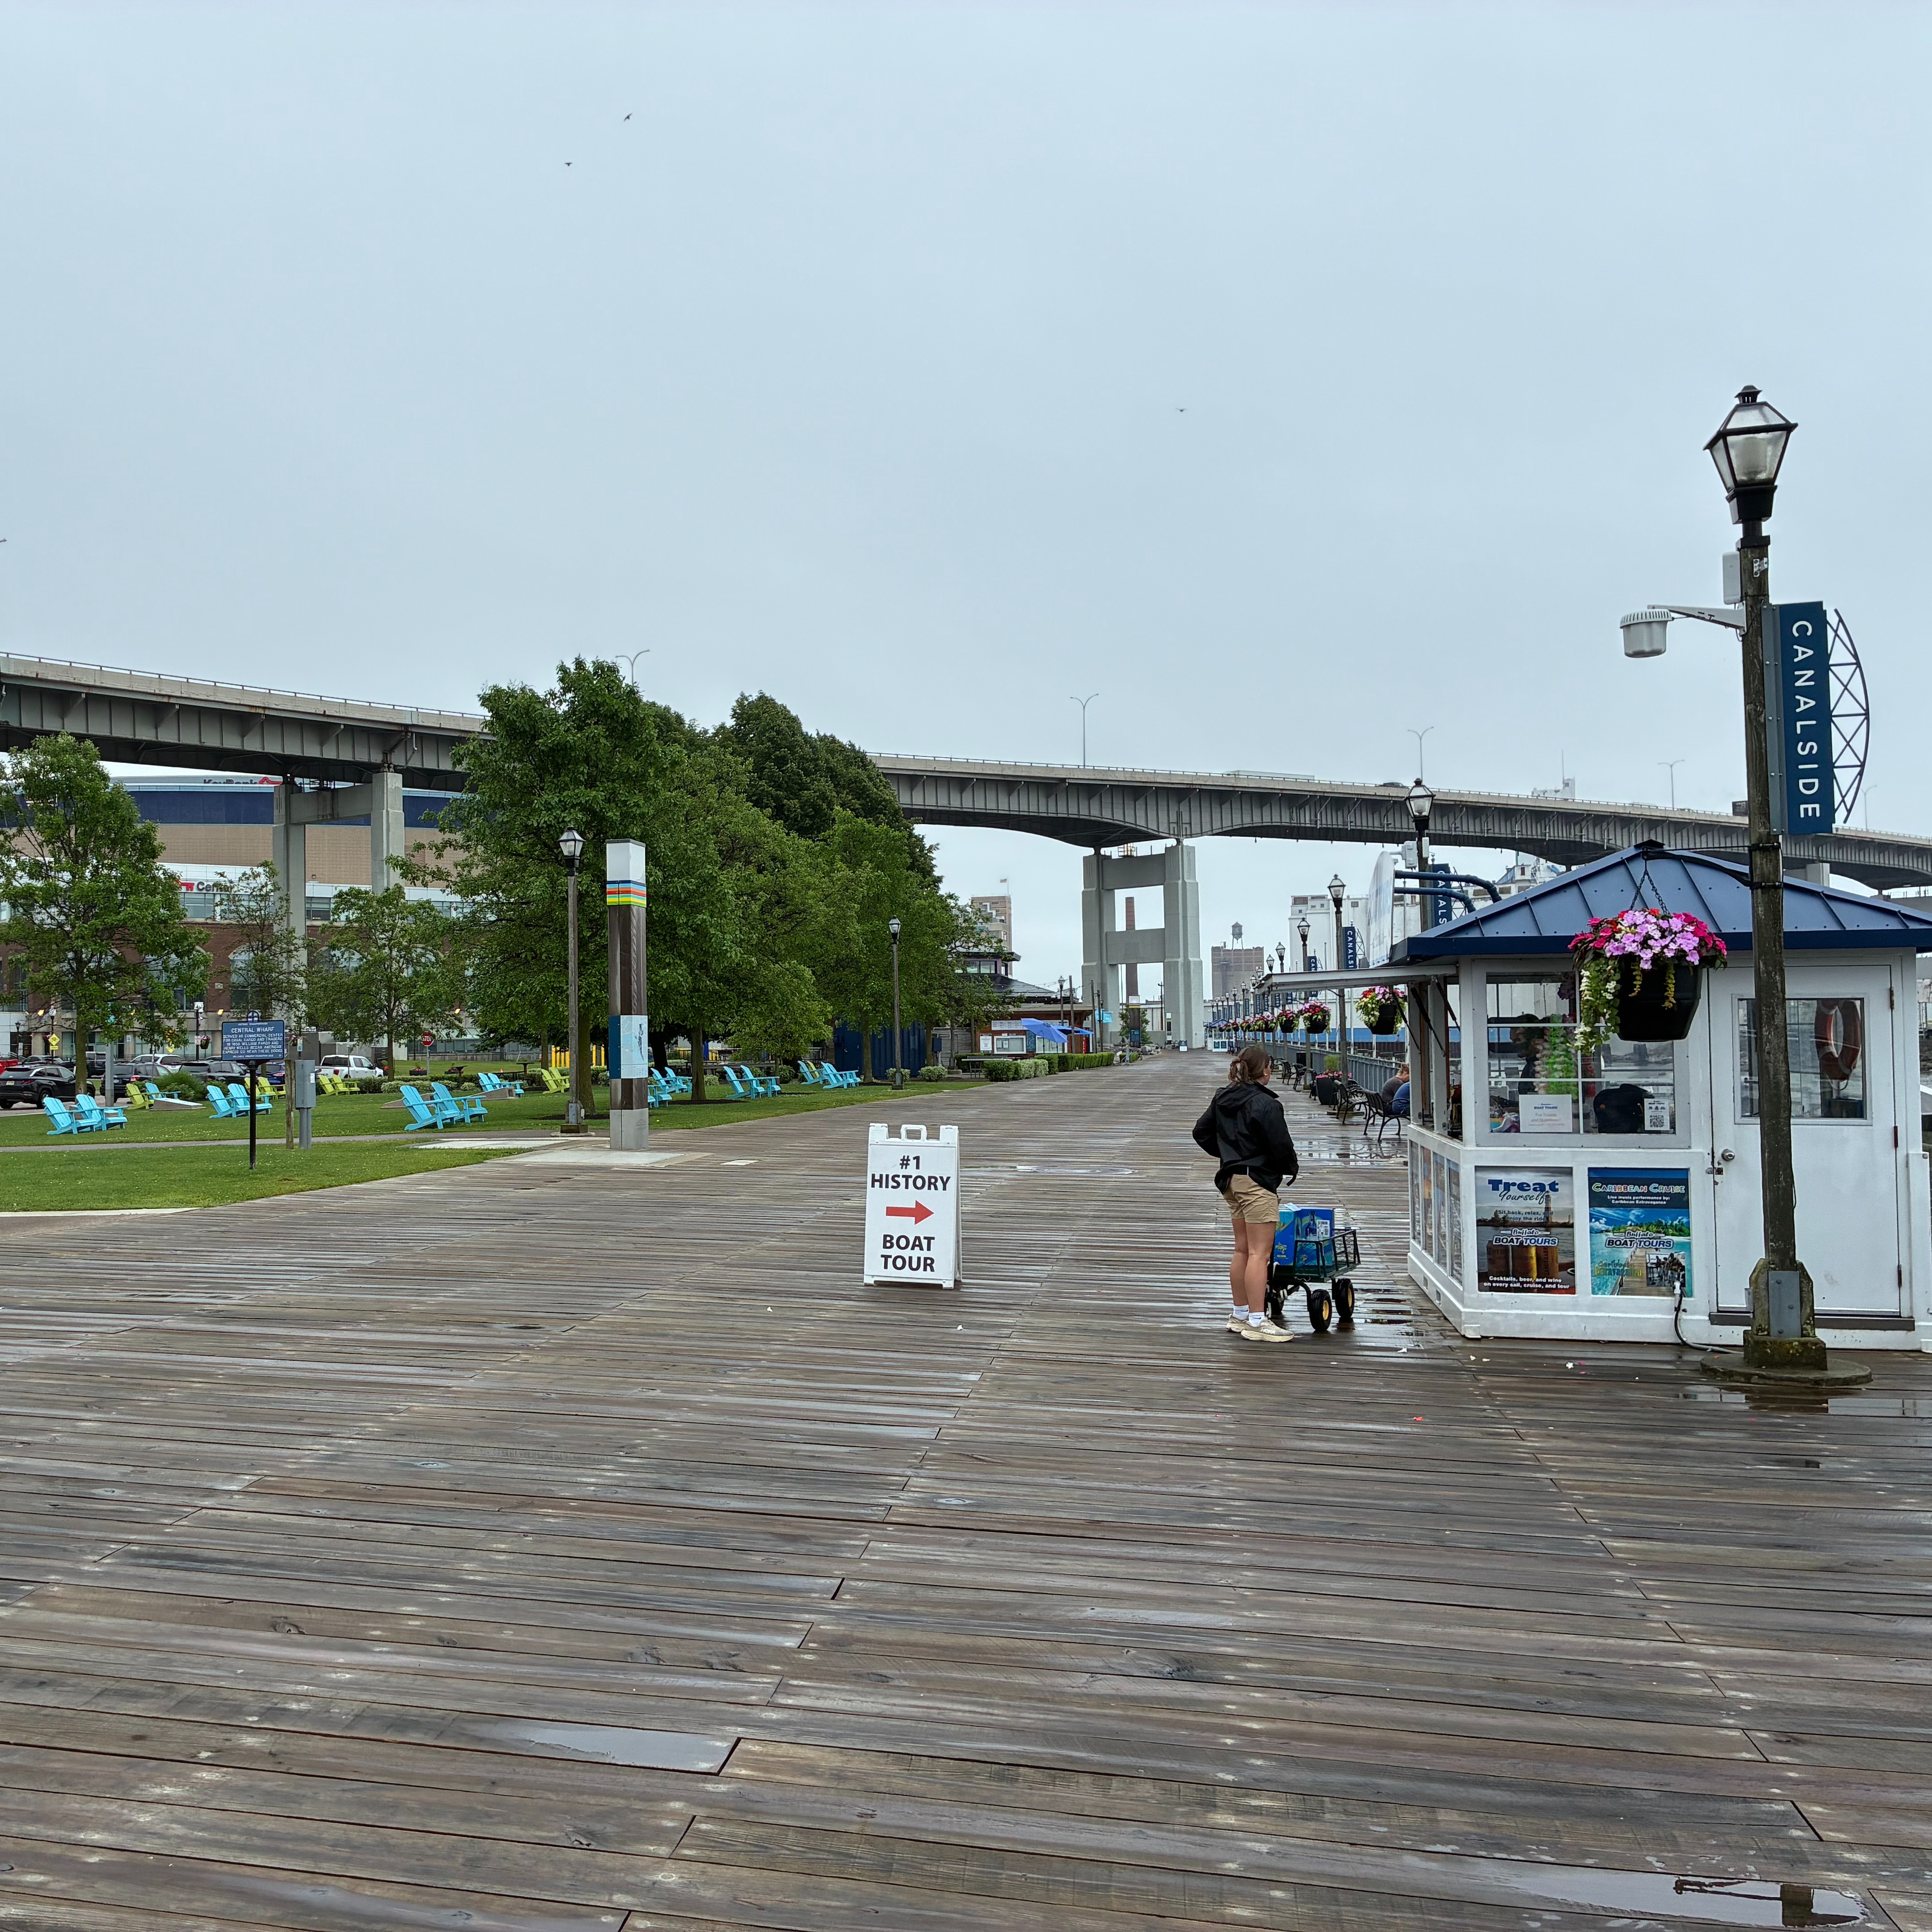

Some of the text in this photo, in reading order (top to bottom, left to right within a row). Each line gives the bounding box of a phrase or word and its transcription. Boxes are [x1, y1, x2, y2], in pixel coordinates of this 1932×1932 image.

[1792, 620, 1820, 819] CANALSIDE
[899, 1155, 920, 1170] #1
[871, 1173, 951, 1191] HISTORY
[1488, 1179, 1559, 1192] Treat
[1499, 1190, 1548, 1205] Yourself
[883, 1234, 935, 1251] BOAT
[1494, 1237, 1557, 1245] BOAT TOURS
[1637, 1240, 1672, 1248] TOURS
[880, 1254, 935, 1272] TOUR
